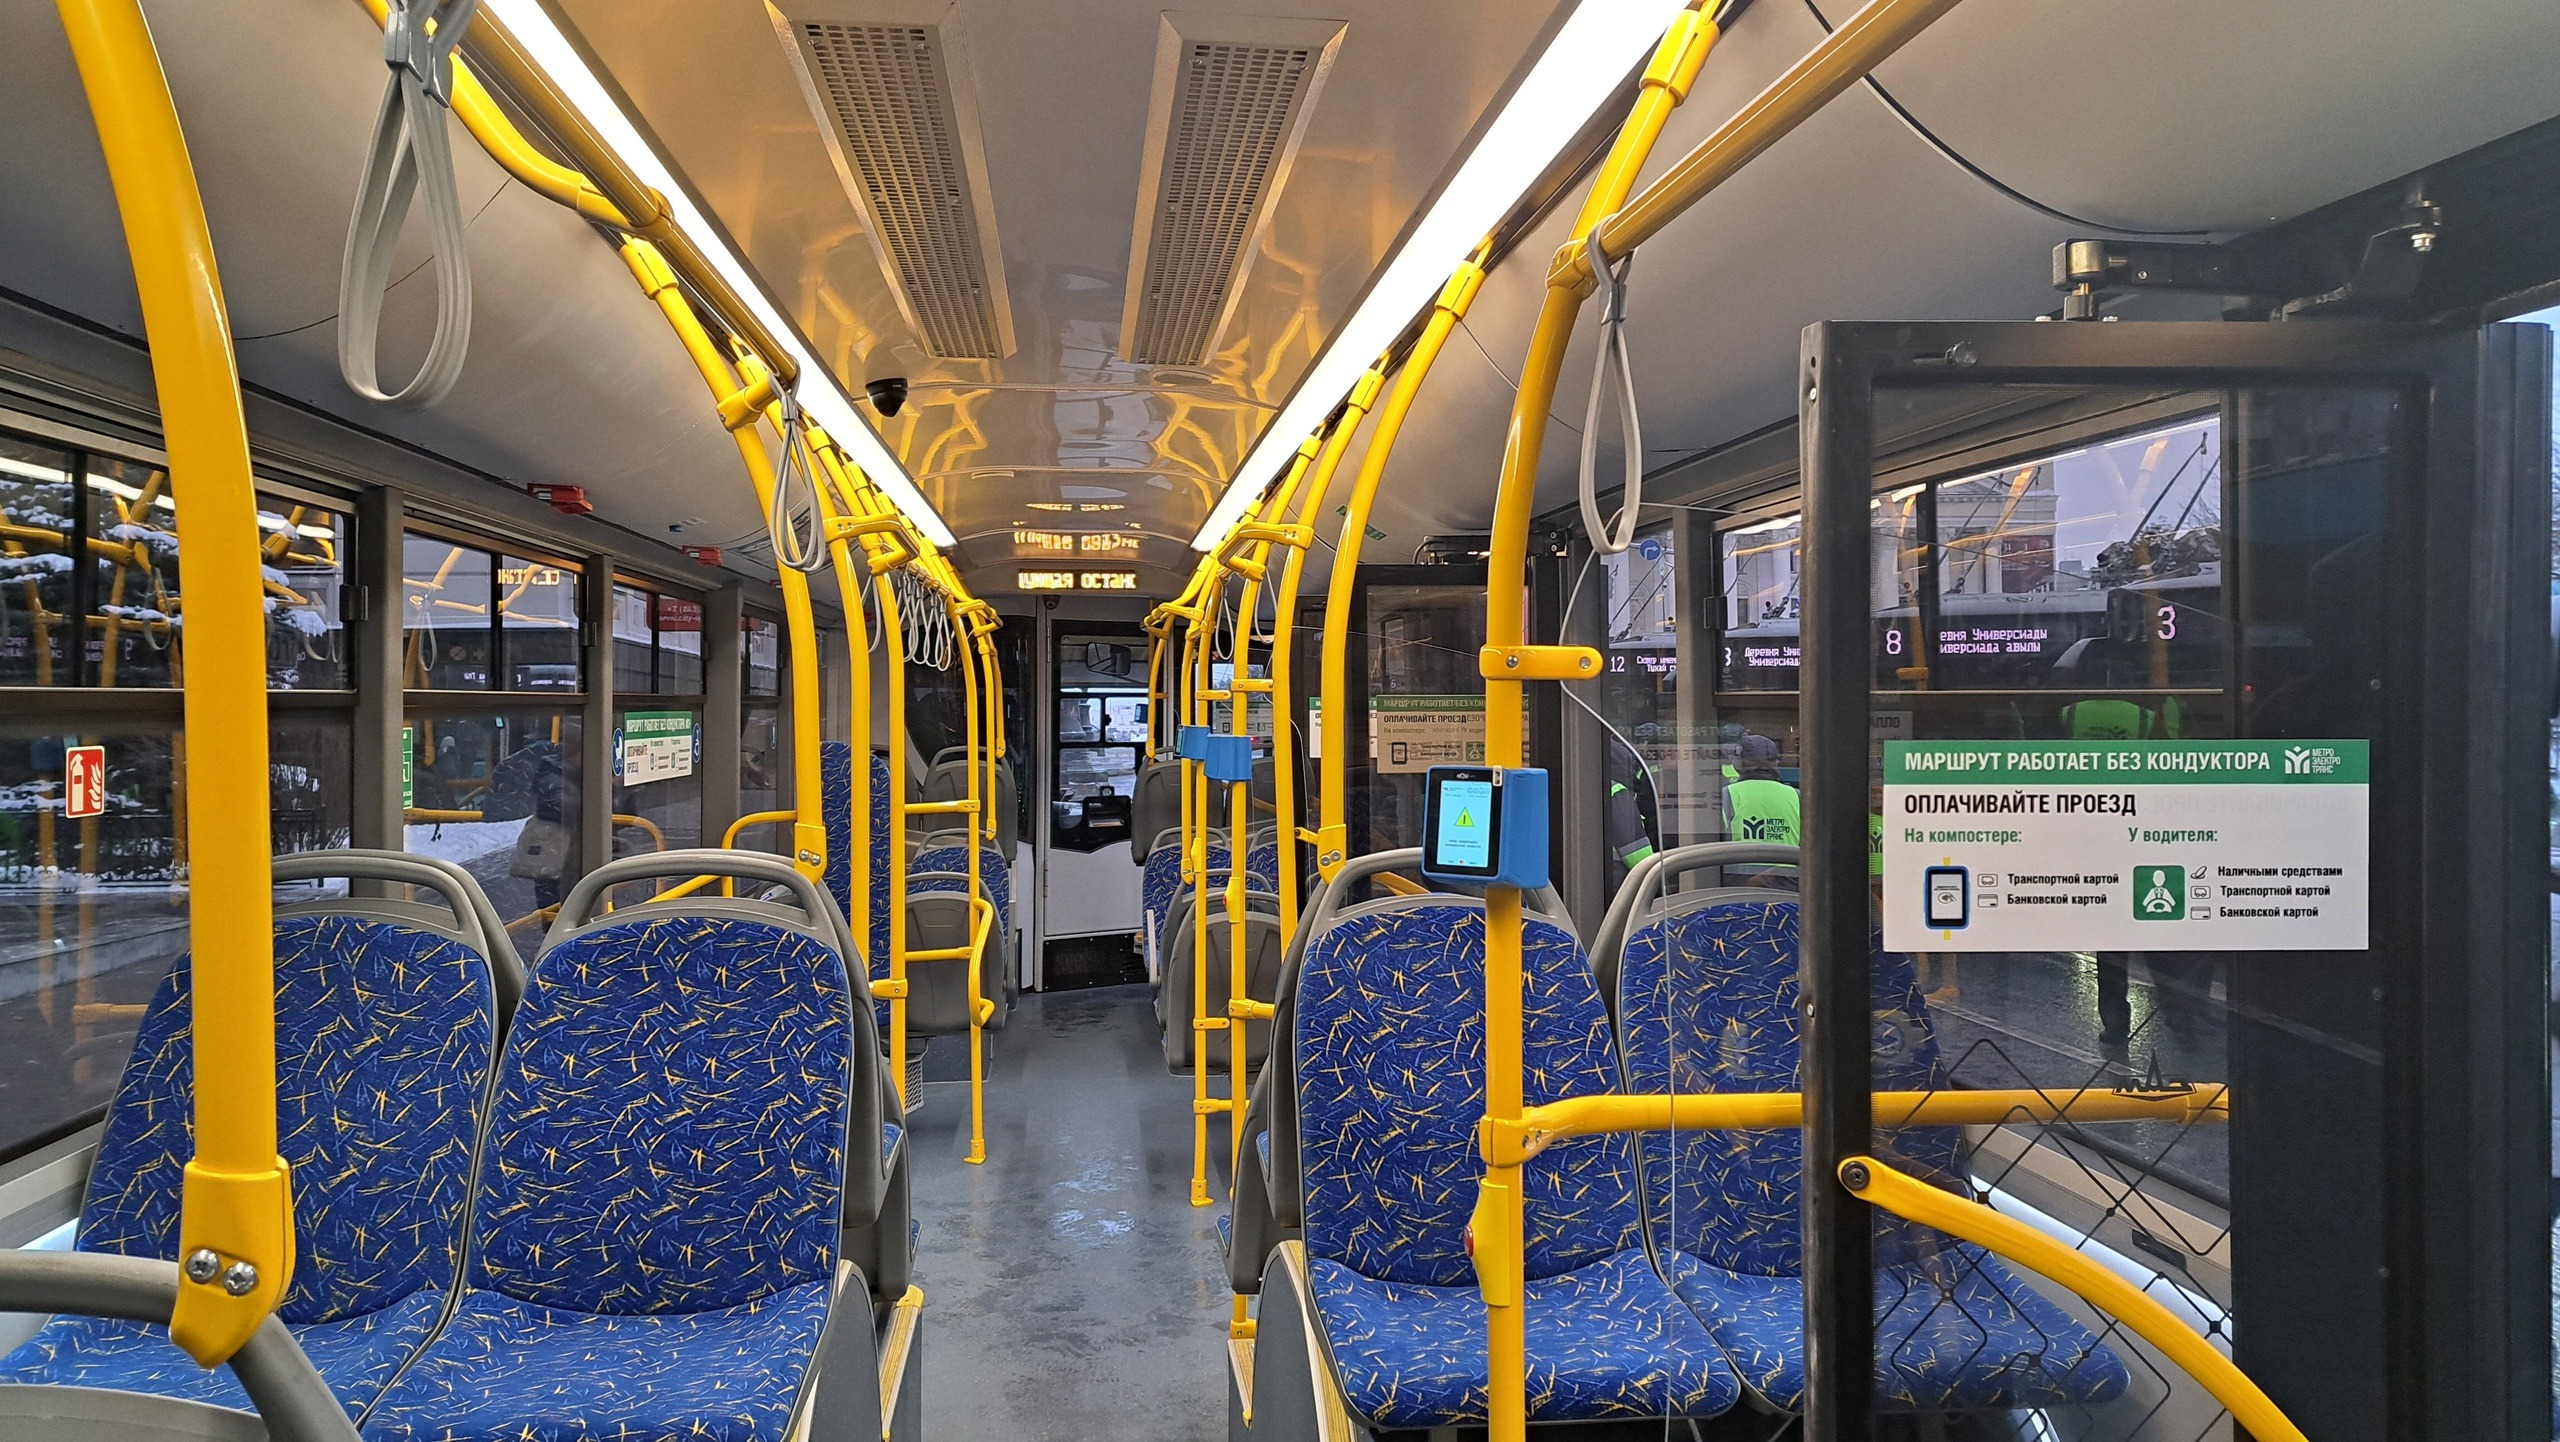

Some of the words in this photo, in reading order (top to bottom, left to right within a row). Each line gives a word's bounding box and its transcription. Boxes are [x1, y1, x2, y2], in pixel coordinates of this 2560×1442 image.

[2157, 604, 2176, 640] 3
[1972, 628, 2048, 640] Универсиады
[1886, 629, 1902, 655] 8
[2005, 641, 2041, 653] авылы
[1744, 647, 1780, 658] Деревня
[1609, 655, 1626, 673] 12
[1383, 713, 1436, 723] ОПЛАЧИВАЙТЕ
[1438, 714, 1467, 724] ПРОЕЗД
[2312, 748, 2335, 757] МЕТРО
[1905, 752, 2002, 771] МАРШРУТ
[2007, 752, 2102, 771] РАБОТАЕТ
[2106, 752, 2141, 771] БЕЗ
[2147, 752, 2270, 774] КОНДУКТОРА
[2312, 757, 2341, 765] ЭЛЕКТРО
[2312, 765, 2334, 774] ТРАНС
[1904, 790, 2050, 814] ОПЛАЧИВАЙТЕ
[2056, 793, 2137, 817] ПРОЕЗД
[1904, 828, 1924, 843] На
[1929, 830, 2022, 846] компостере:
[2128, 828, 2139, 843] У
[2143, 829, 2218, 845] водителя:
[2007, 873, 2081, 887] Транспортной
[2083, 872, 2119, 886] картой
[2217, 865, 2279, 878] Наличными
[2281, 865, 2343, 879] средствами
[2219, 885, 2293, 899] Транспортной
[2295, 884, 2331, 898] картой
[2007, 892, 2069, 905] Банковской
[2071, 892, 2107, 907] картой
[2219, 906, 2281, 918] Банковской
[2283, 905, 2319, 920] картой
